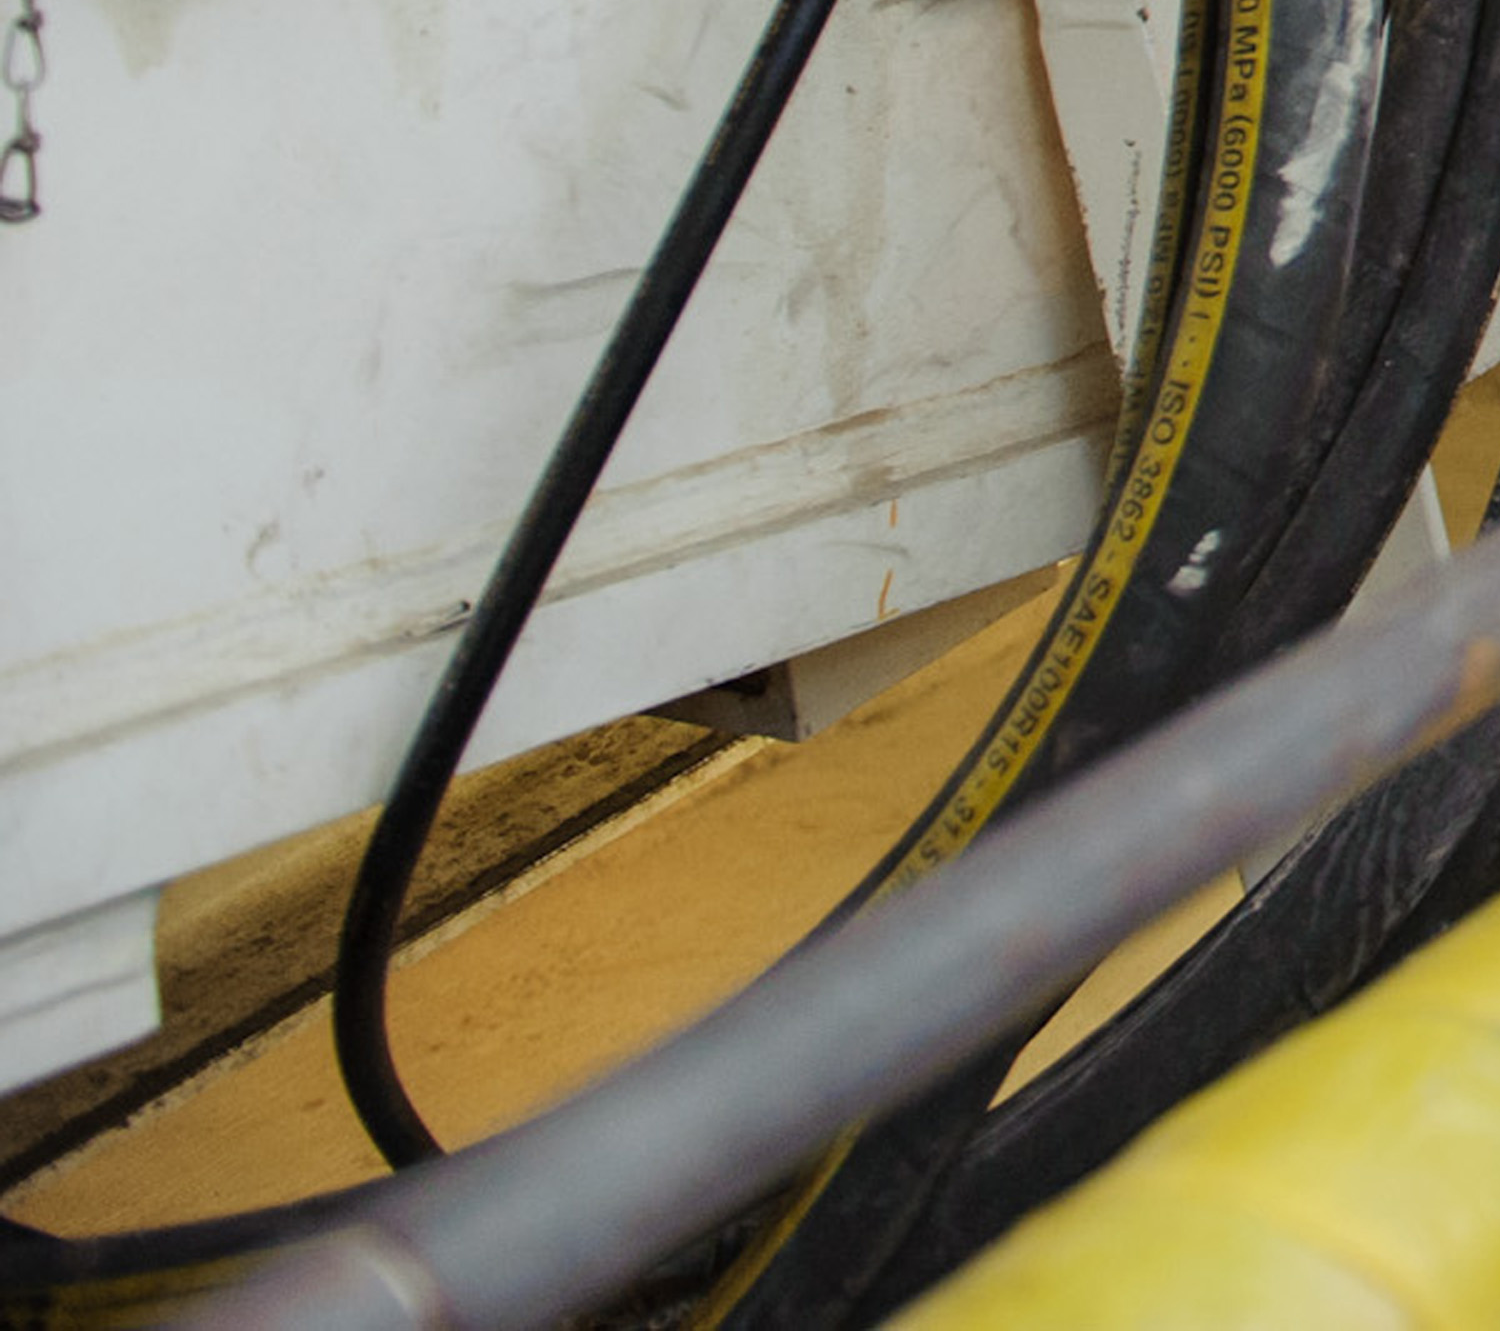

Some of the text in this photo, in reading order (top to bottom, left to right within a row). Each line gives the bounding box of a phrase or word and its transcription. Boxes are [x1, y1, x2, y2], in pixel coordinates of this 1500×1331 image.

[1226, 25, 1260, 104] MPa
[1213, 114, 1253, 212] (6000
[1192, 223, 1234, 301] PSI)
[1148, 377, 1192, 449] ISO
[1111, 455, 1164, 544] 3862
[985, 572, 1113, 777] SAE100R15
